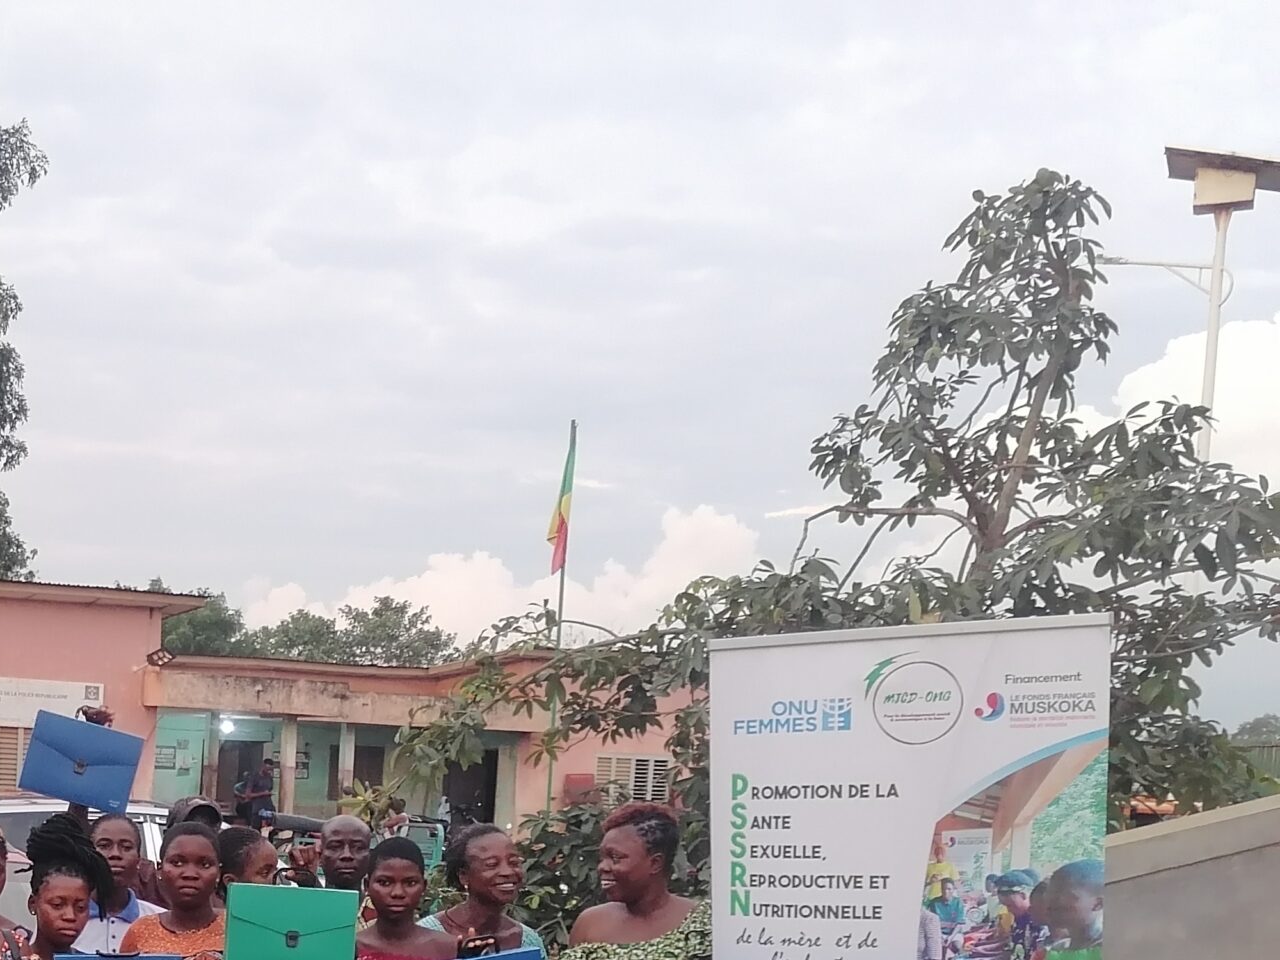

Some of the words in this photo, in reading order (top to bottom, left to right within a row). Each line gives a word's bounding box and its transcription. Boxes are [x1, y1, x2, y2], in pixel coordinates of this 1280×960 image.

[1004, 672, 1083, 684] Financement
[1022, 693, 1051, 701] FONDS
[1052, 692, 1096, 700] FRANÇAIS
[772, 700, 818, 716] ONU
[1009, 700, 1096, 714] MUSKOKA
[734, 717, 818, 735] FEMMES
[731, 773, 843, 800] PROMOTION
[848, 784, 870, 798] DE
[875, 783, 899, 798] LA
[730, 802, 791, 830] SANTE
[731, 861, 864, 889] REPRODUCTIVE
[869, 875, 890, 889] ET
[736, 928, 752, 945] de
[758, 927, 774, 946] la
[780, 932, 822, 948] mère
[835, 933, 853, 949] et
[857, 931, 879, 949] de
